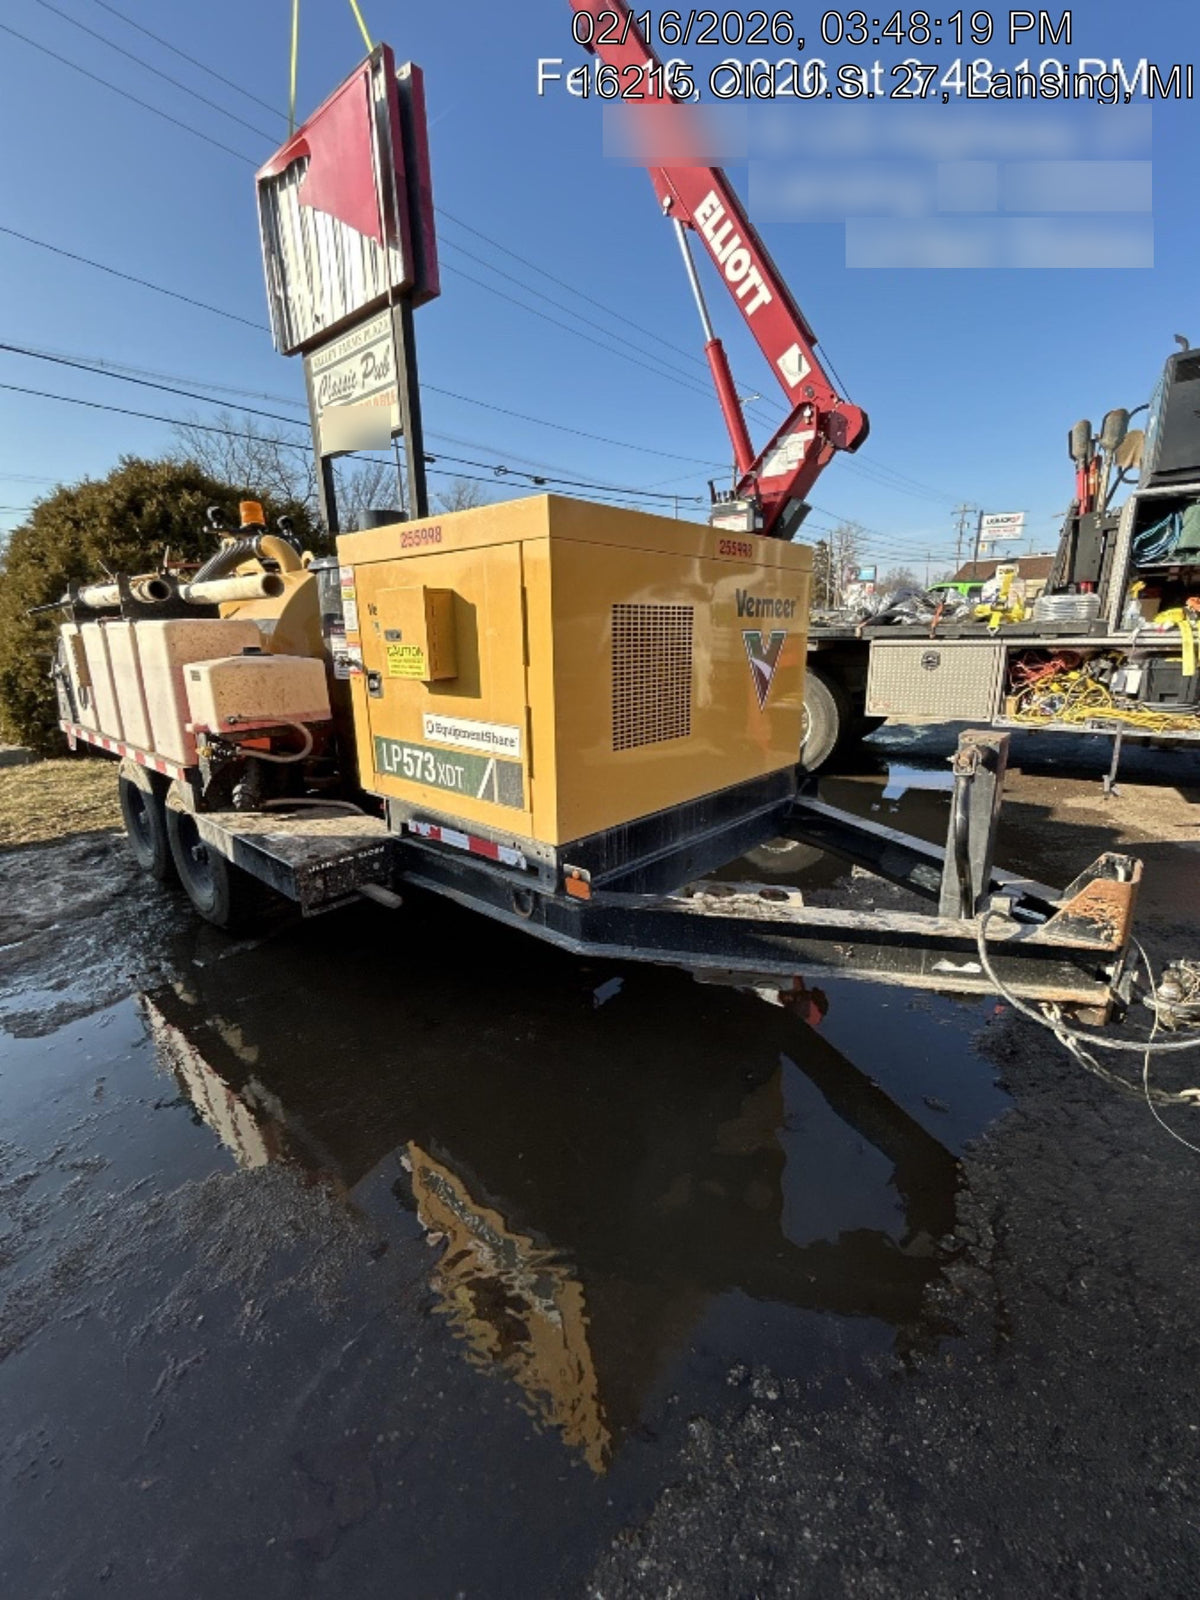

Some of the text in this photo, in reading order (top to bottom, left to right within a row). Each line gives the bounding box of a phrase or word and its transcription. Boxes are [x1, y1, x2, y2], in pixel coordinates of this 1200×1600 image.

[694, 190, 773, 316] ELLIOTT
[317, 370, 358, 411] Classic
[360, 344, 391, 390] Pub
[400, 525, 442, 549] 255998
[735, 588, 796, 618] Vermeer
[386, 644, 424, 657] CAUTION
[436, 722, 517, 748] EquipmentShare
